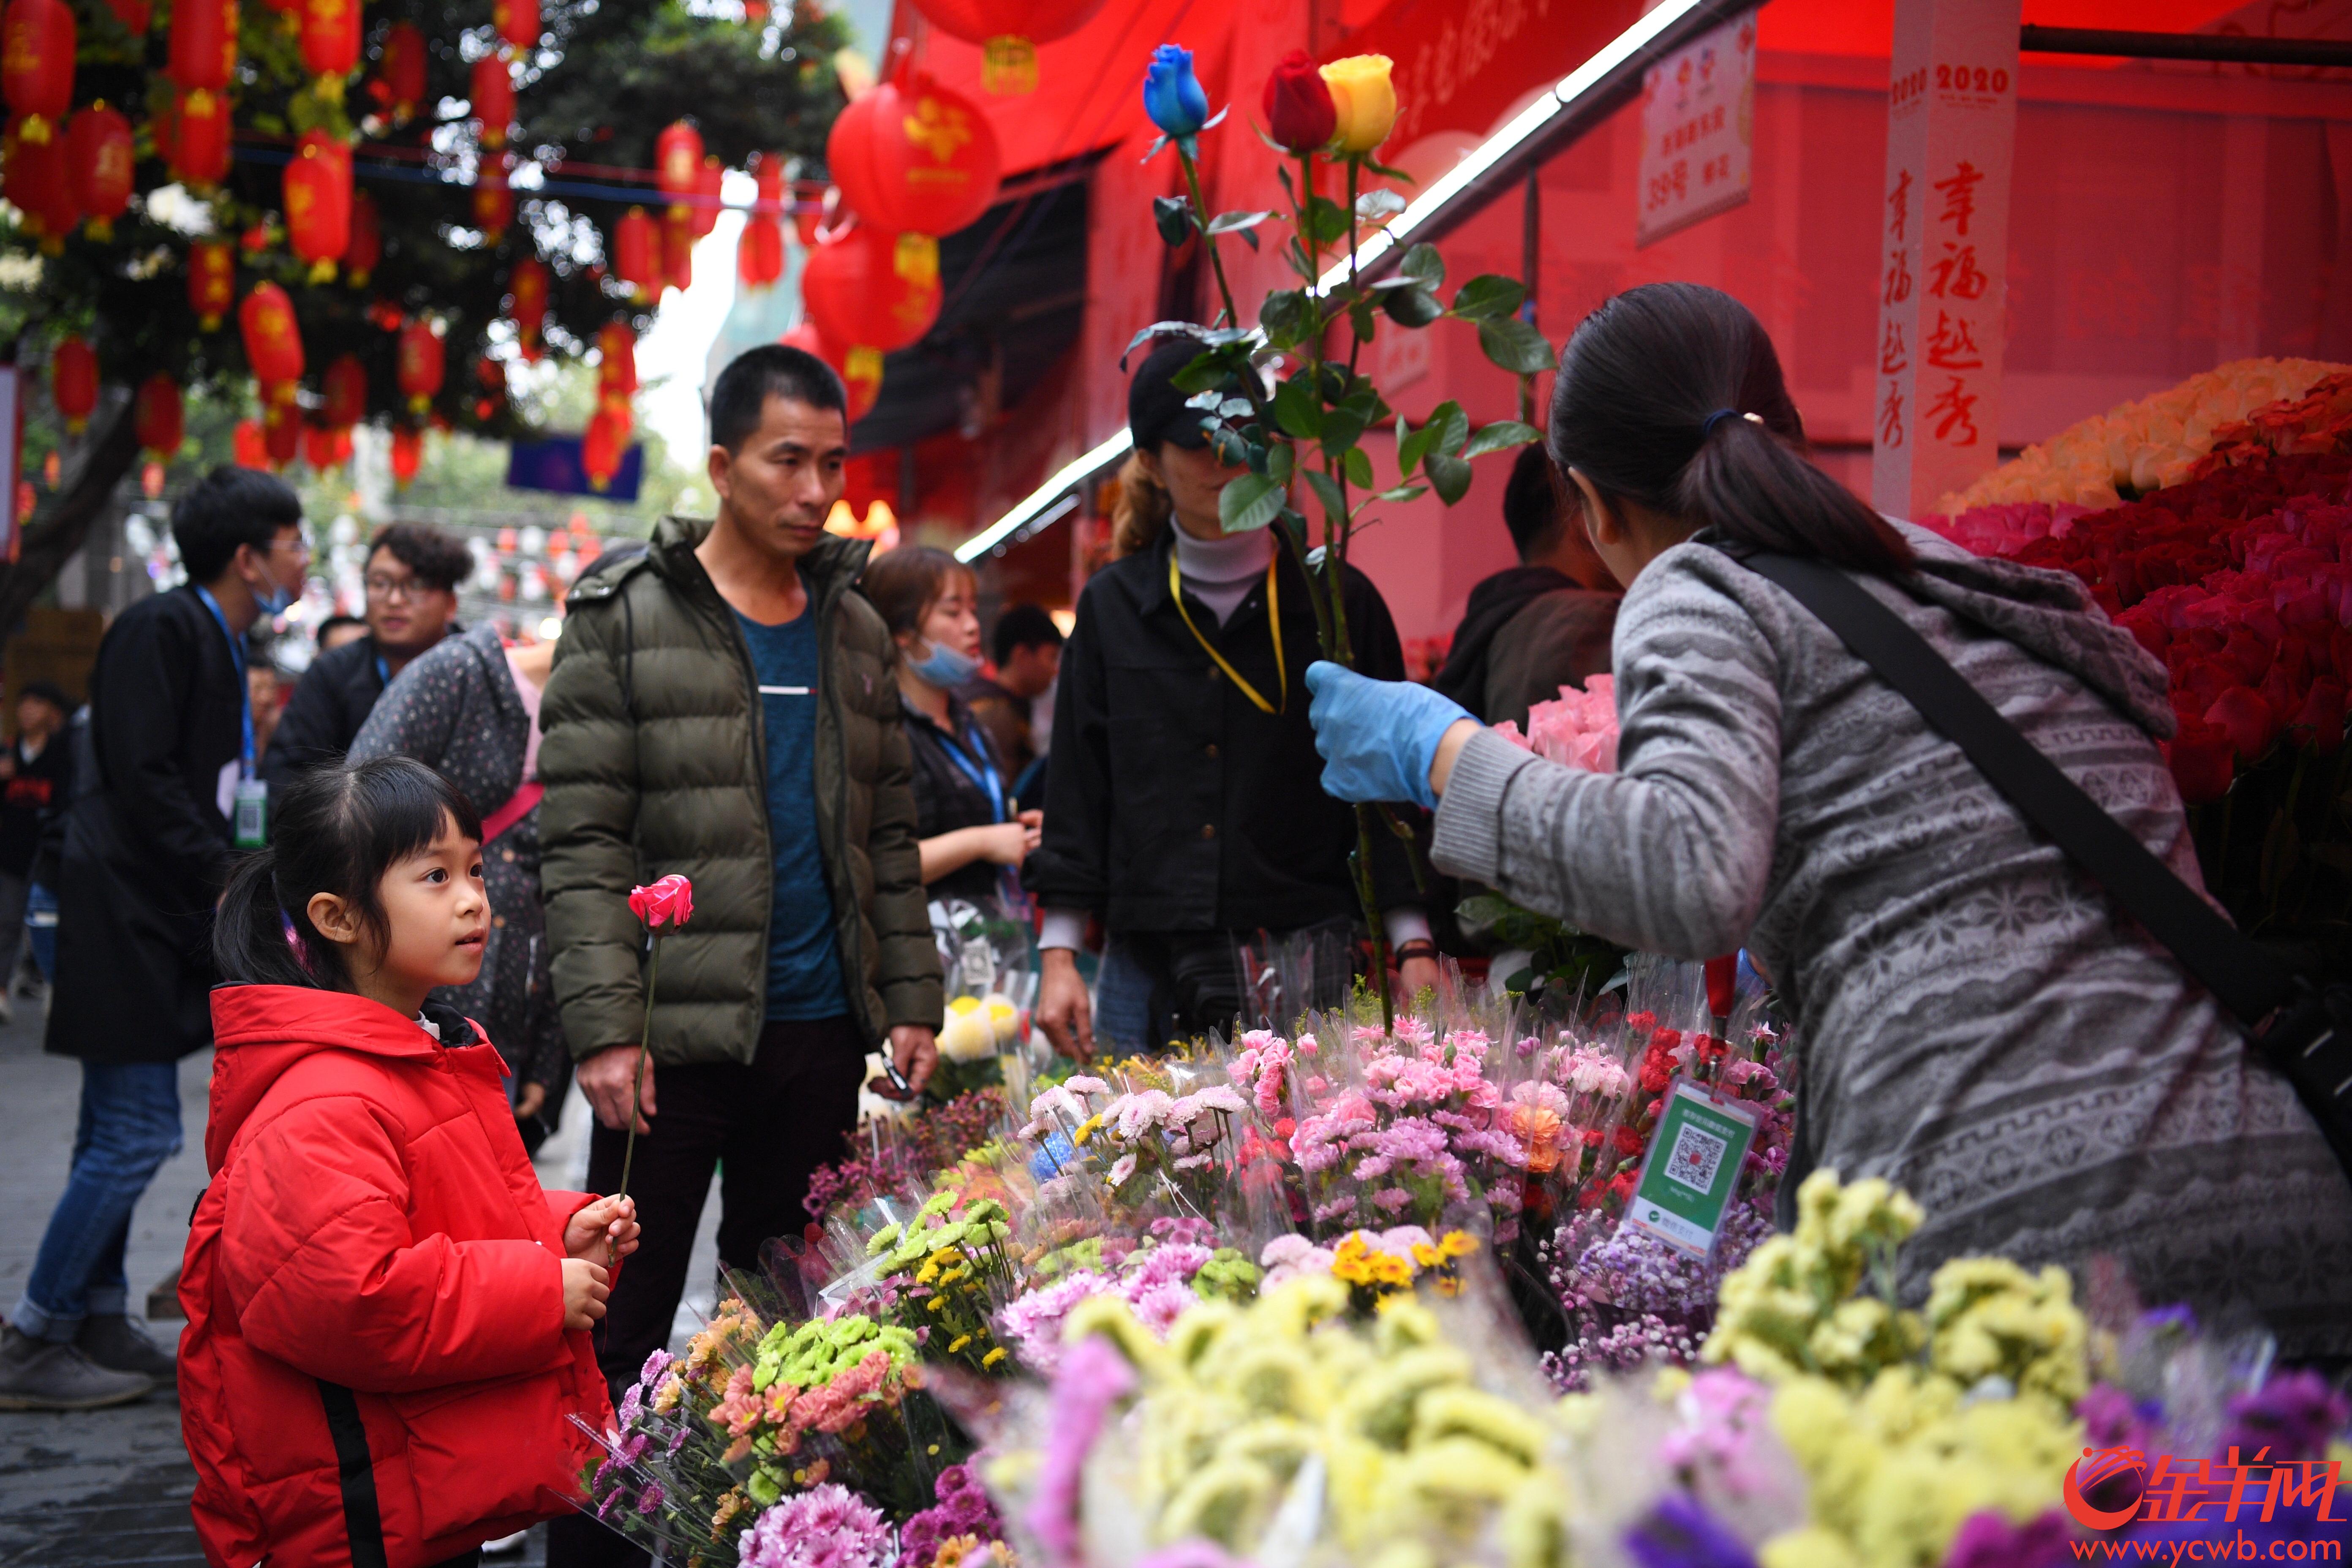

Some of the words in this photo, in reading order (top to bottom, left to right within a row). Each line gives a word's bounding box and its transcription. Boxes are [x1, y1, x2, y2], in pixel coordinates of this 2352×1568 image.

[1893, 67, 1927, 105] 2020
[1936, 63, 2009, 94] 2020
[1879, 169, 1913, 449] 幸福越秀
[1924, 159, 1989, 446] 幸福越秀
